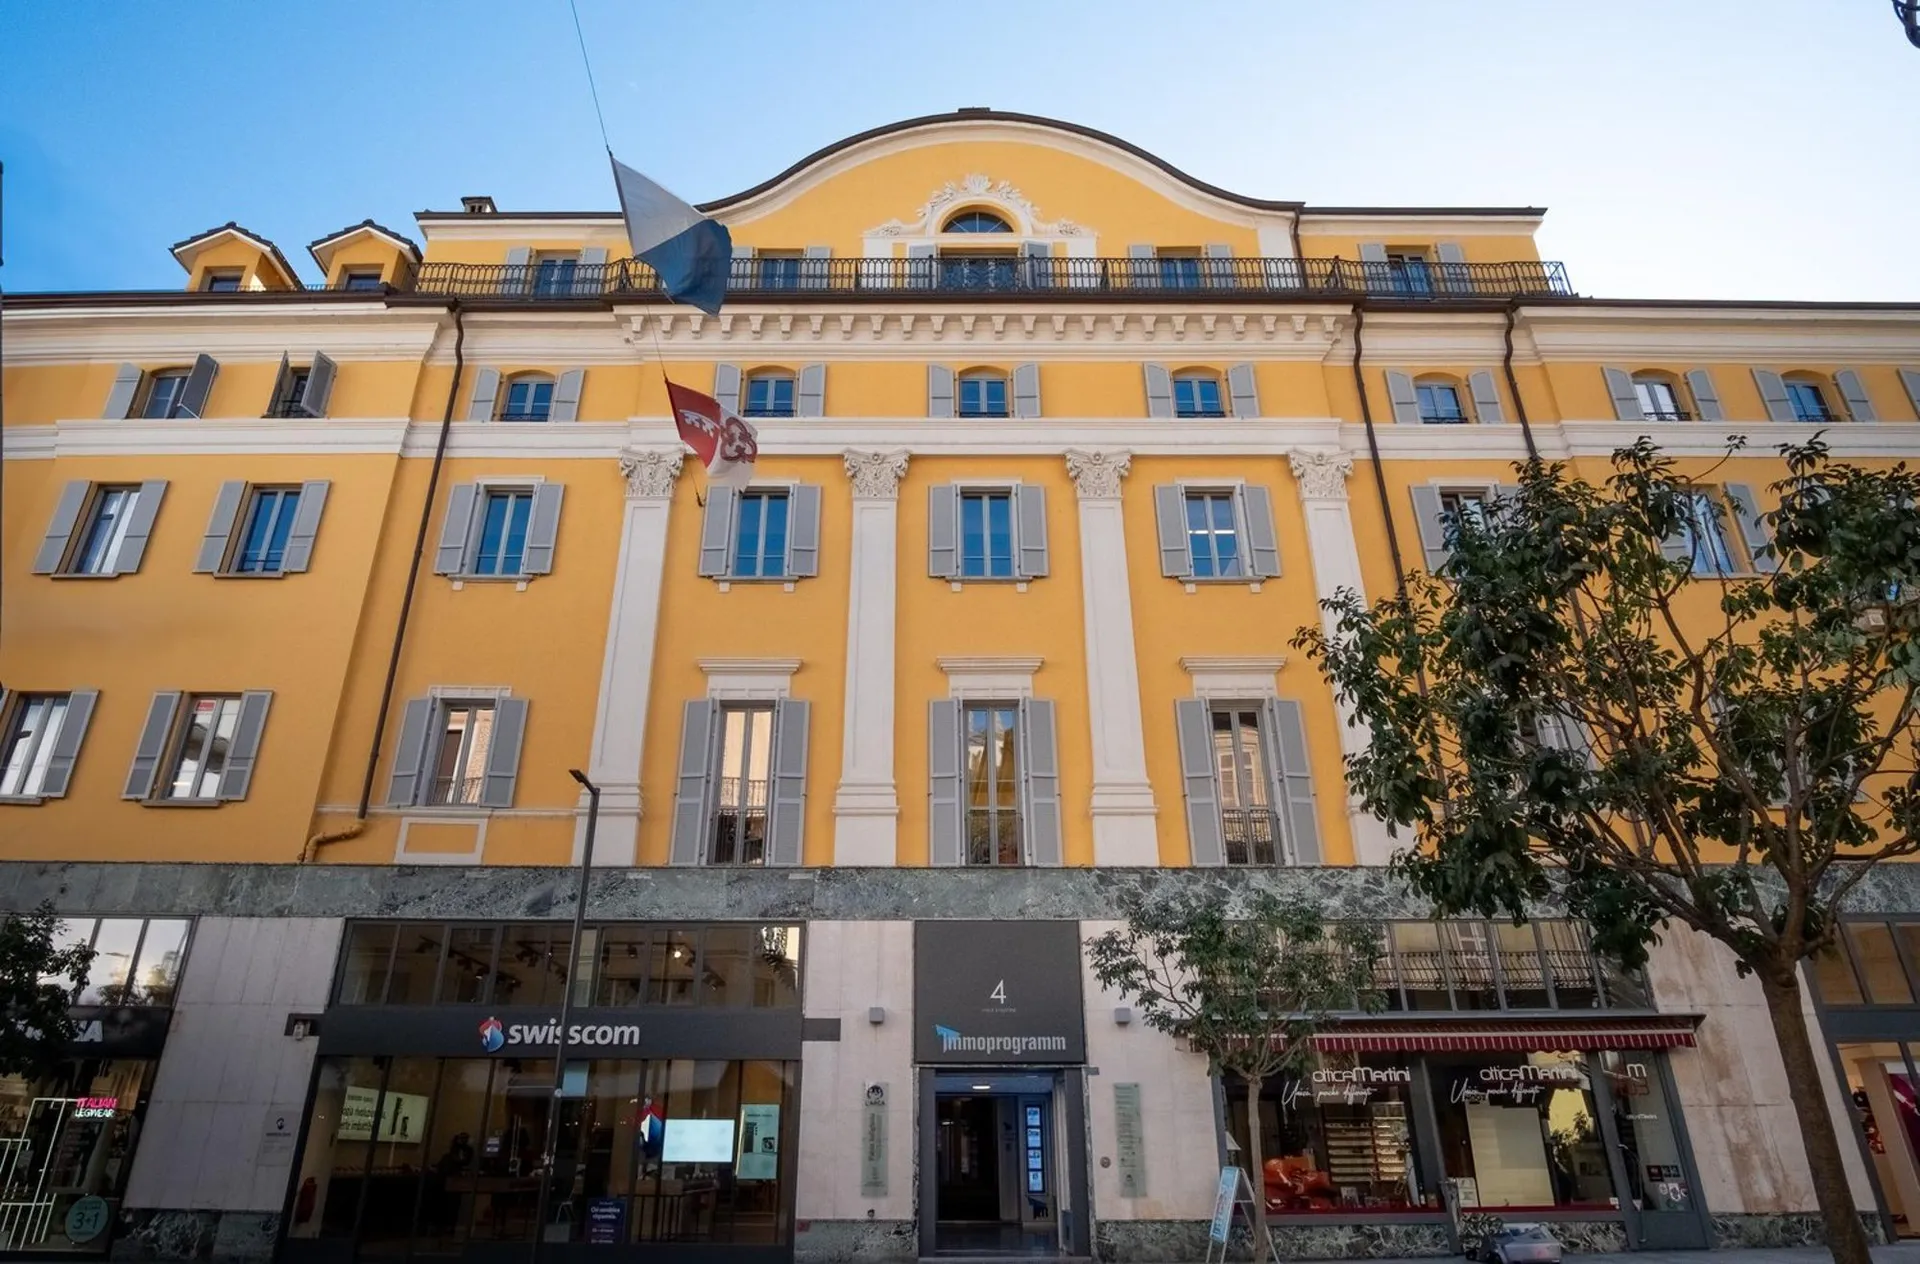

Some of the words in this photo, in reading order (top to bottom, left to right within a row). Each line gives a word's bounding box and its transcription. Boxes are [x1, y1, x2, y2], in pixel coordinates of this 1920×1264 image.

[990, 980, 1006, 1004] 4
[77, 1097, 118, 1108] ITALIAN
[75, 1108, 115, 1118] LEGWEAR
